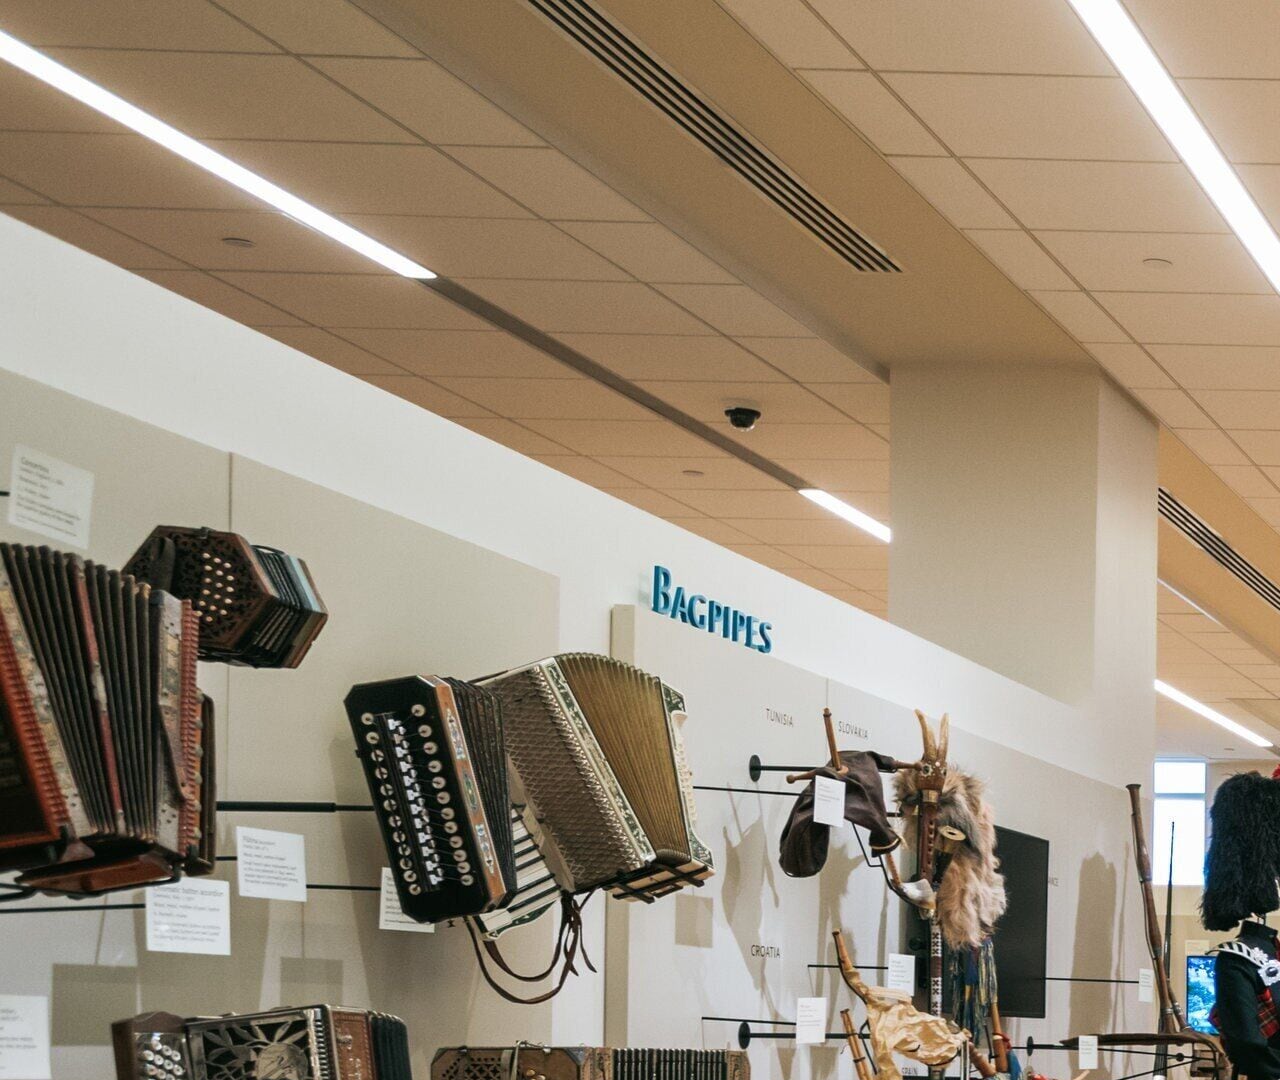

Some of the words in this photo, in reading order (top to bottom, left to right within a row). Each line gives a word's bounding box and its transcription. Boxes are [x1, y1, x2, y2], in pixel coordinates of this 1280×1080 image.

[651, 565, 772, 654] BAGPIPES
[765, 708, 794, 728] TUNISIA
[838, 720, 869, 740] SLOVAKIA
[750, 944, 781, 959] CROATIA
